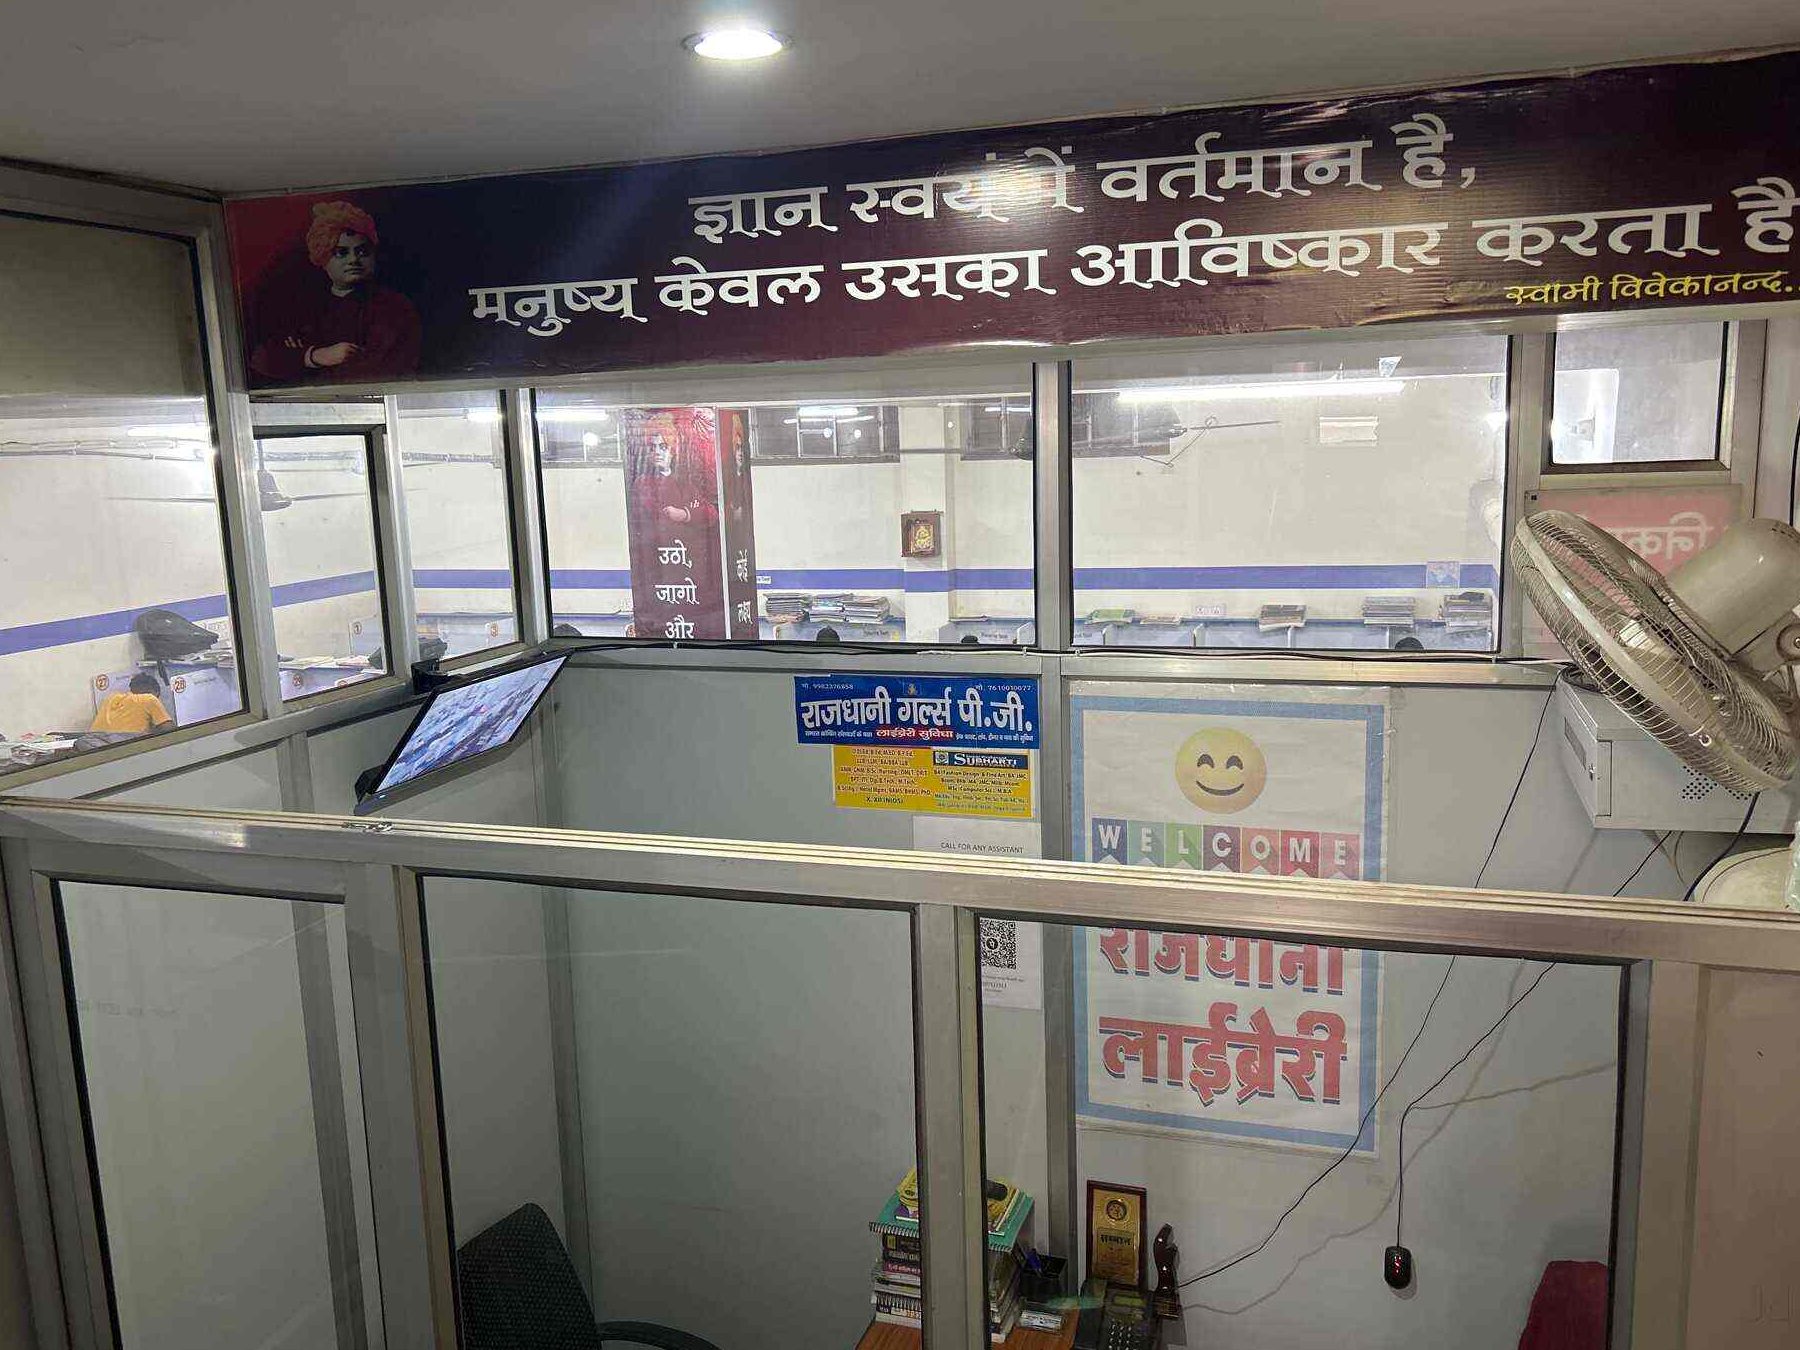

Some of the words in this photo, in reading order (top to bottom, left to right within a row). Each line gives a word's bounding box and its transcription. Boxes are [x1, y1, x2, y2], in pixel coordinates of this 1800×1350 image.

[688, 186, 838, 244] ज्ञान
[1096, 132, 1383, 202] वर्तमान
[1389, 112, 1477, 189] है,
[468, 278, 648, 338] मनुष्य
[654, 257, 825, 316] केवल
[841, 249, 1058, 300] उसका
[1070, 218, 1450, 288] आविष्कार
[1471, 203, 1721, 267] करता
[1730, 176, 1800, 254] है
[1504, 275, 1604, 306] स्वामी
[655, 577, 700, 605] जागो
[665, 614, 695, 639] और
[800, 685, 891, 728] राजधानी
[896, 687, 952, 726] गर्ल्स
[972, 844, 987, 852] ANY
[988, 845, 1024, 854] ASSISTANT
[1098, 824, 1347, 867] WELCOME
[1099, 1002, 1348, 1108] लाईब्रेरी
